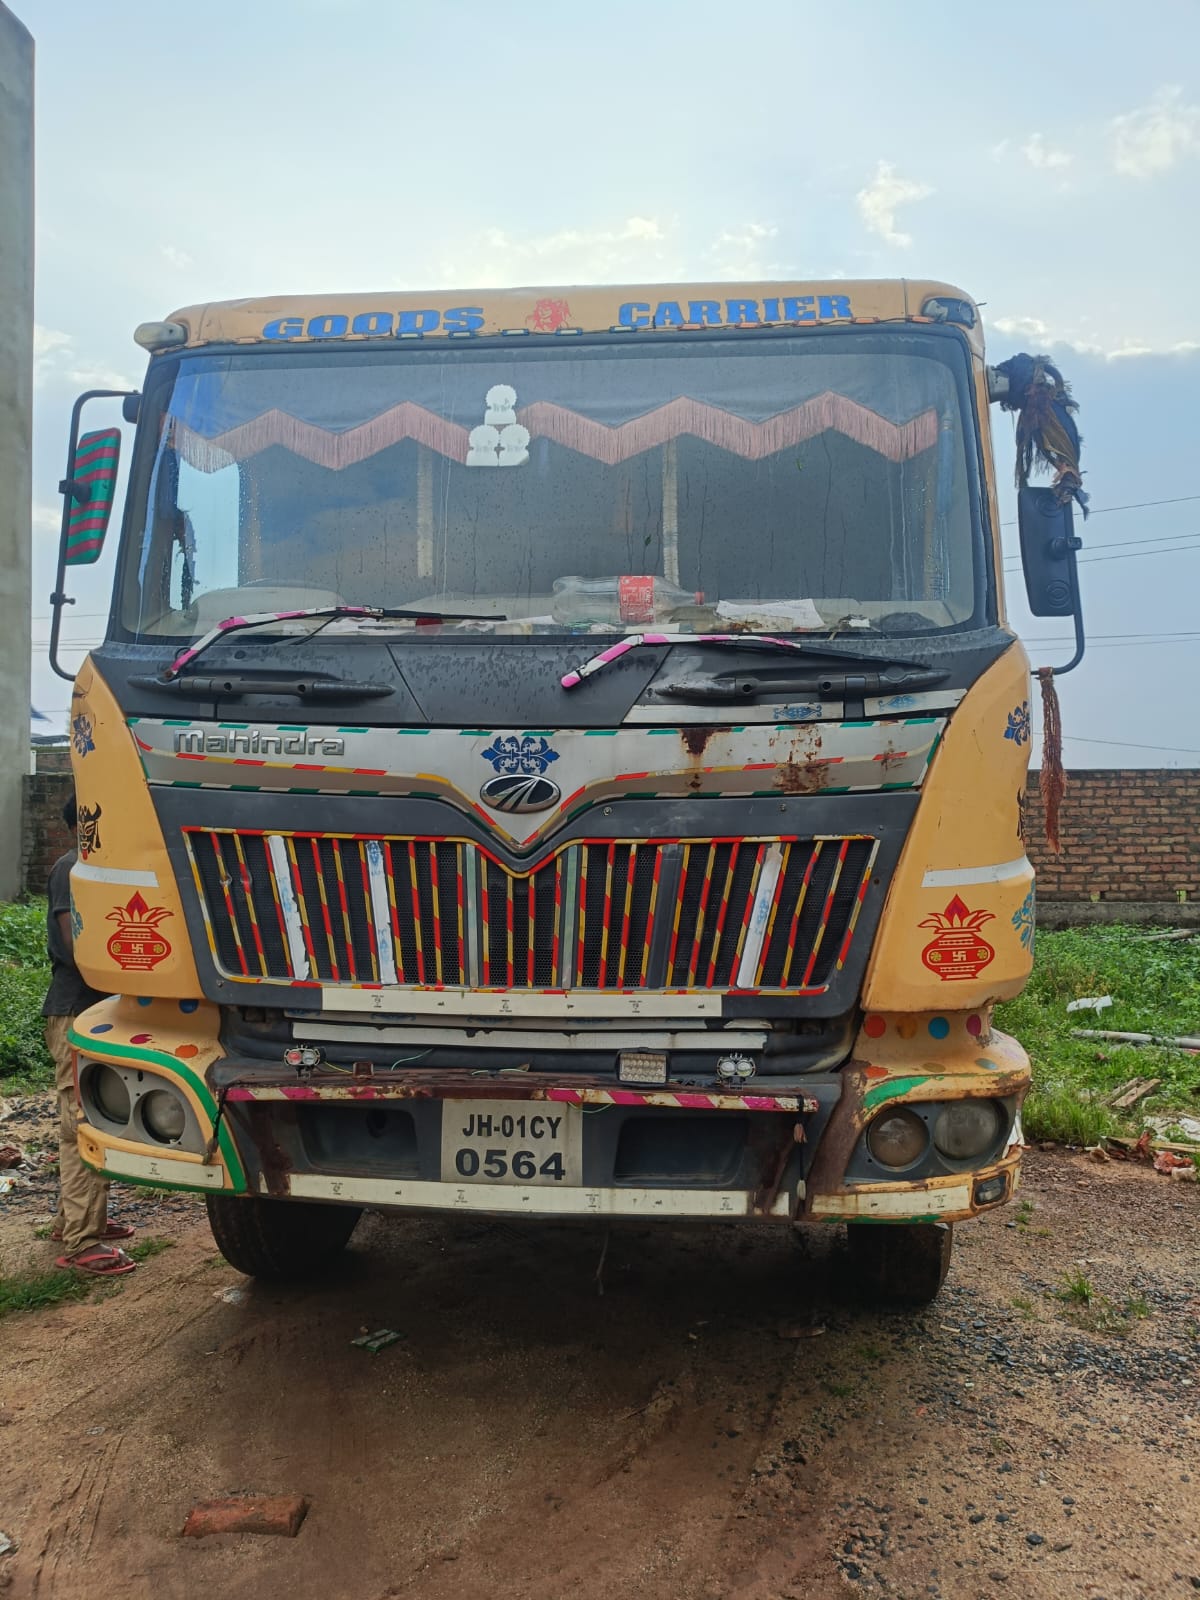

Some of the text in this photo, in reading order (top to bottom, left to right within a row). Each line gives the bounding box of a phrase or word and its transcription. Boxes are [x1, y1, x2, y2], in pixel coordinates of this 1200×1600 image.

[262, 295, 853, 339] GOODS CARRIER
[462, 1114, 562, 1139] JH-01CY
[455, 1148, 566, 1181] 0564
